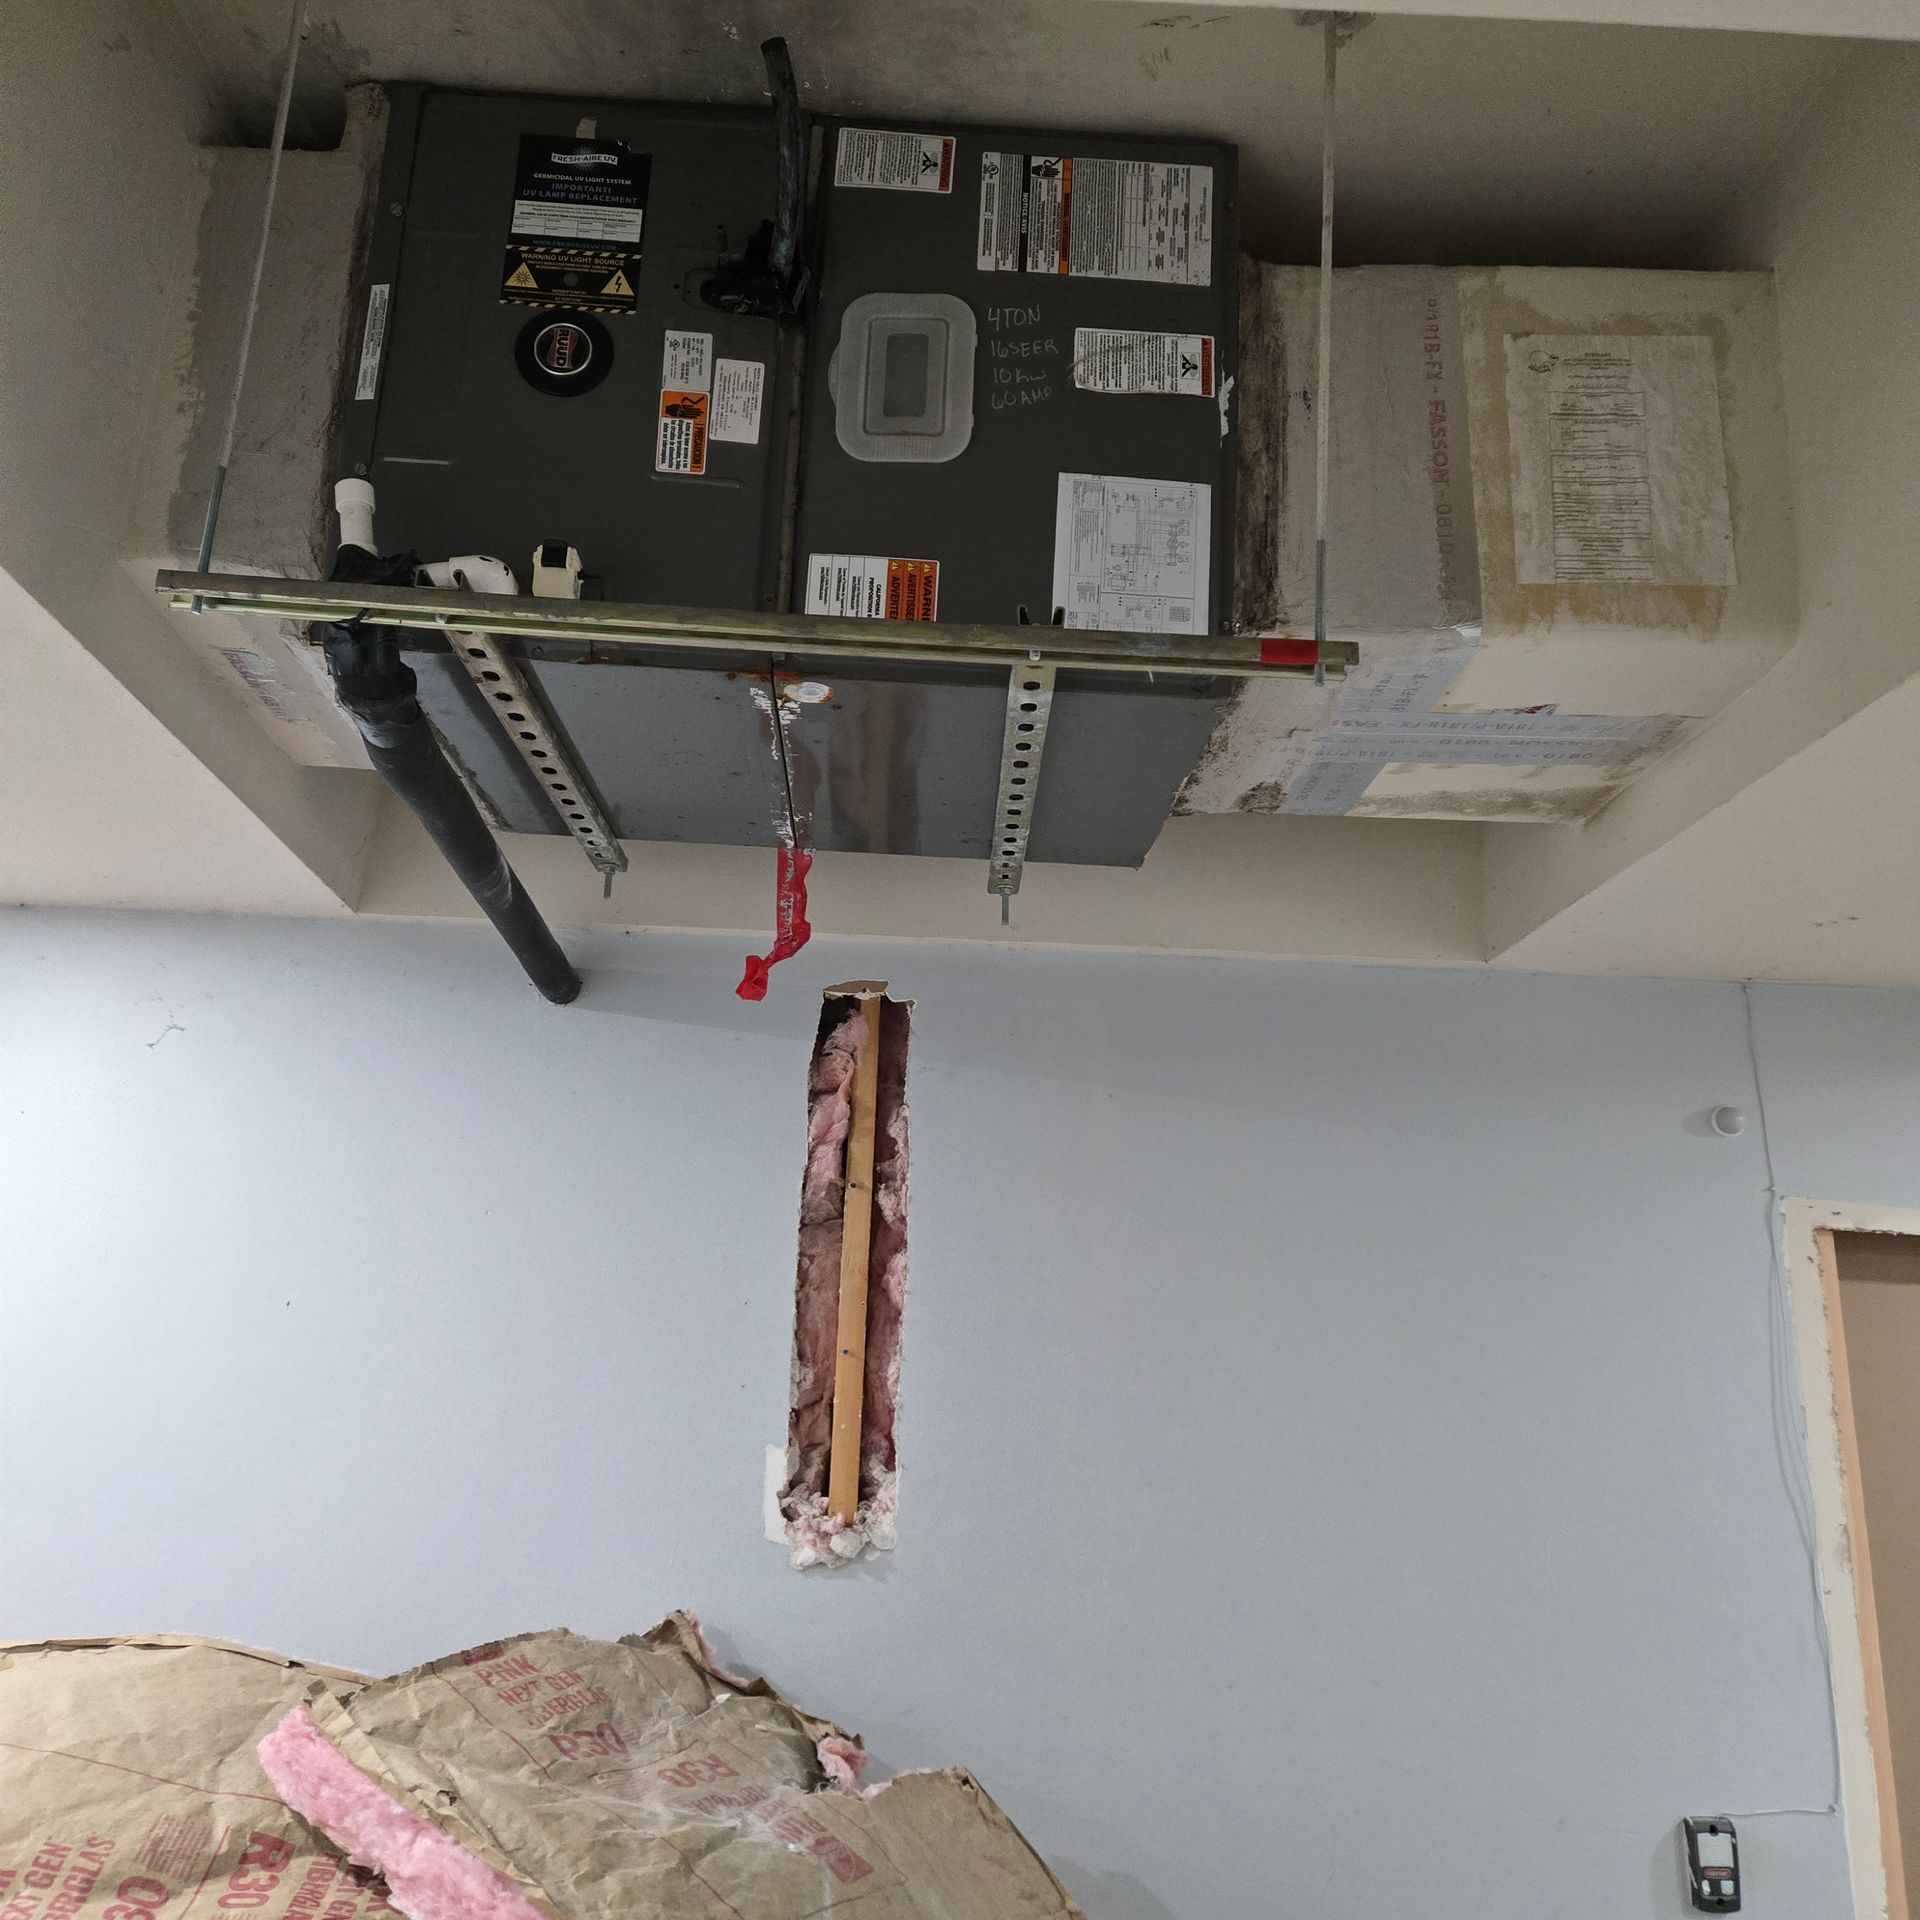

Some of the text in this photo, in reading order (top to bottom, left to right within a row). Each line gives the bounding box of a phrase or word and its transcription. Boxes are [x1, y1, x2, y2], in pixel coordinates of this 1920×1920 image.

[522, 188, 638, 205] UV LAMP REPLACEMENT
[533, 172, 574, 182] GERMICIDAL
[584, 175, 606, 184] LIGHT
[606, 178, 632, 186] SYSTEM
[521, 252, 557, 262] WARNING
[570, 256, 592, 264] LIGHT
[594, 258, 625, 267] SOURCE
[556, 328, 570, 368] RUUD
[1428, 398, 1450, 484] FASSON
[1434, 502, 1456, 554] 0810
[866, 576, 875, 613] PROPOSITION
[874, 584, 882, 616] CALIFORNIA
[906, 573, 917, 620] AVERTISSE
[922, 574, 933, 621] WARNI
[474, 1654, 543, 1688] PINK
[496, 1668, 584, 1707] NEXT GEN
[546, 1722, 629, 1761] R30
[657, 1753, 740, 1788] R30
[24, 1840, 72, 1889] GEN
[218, 1830, 297, 1910] R30
